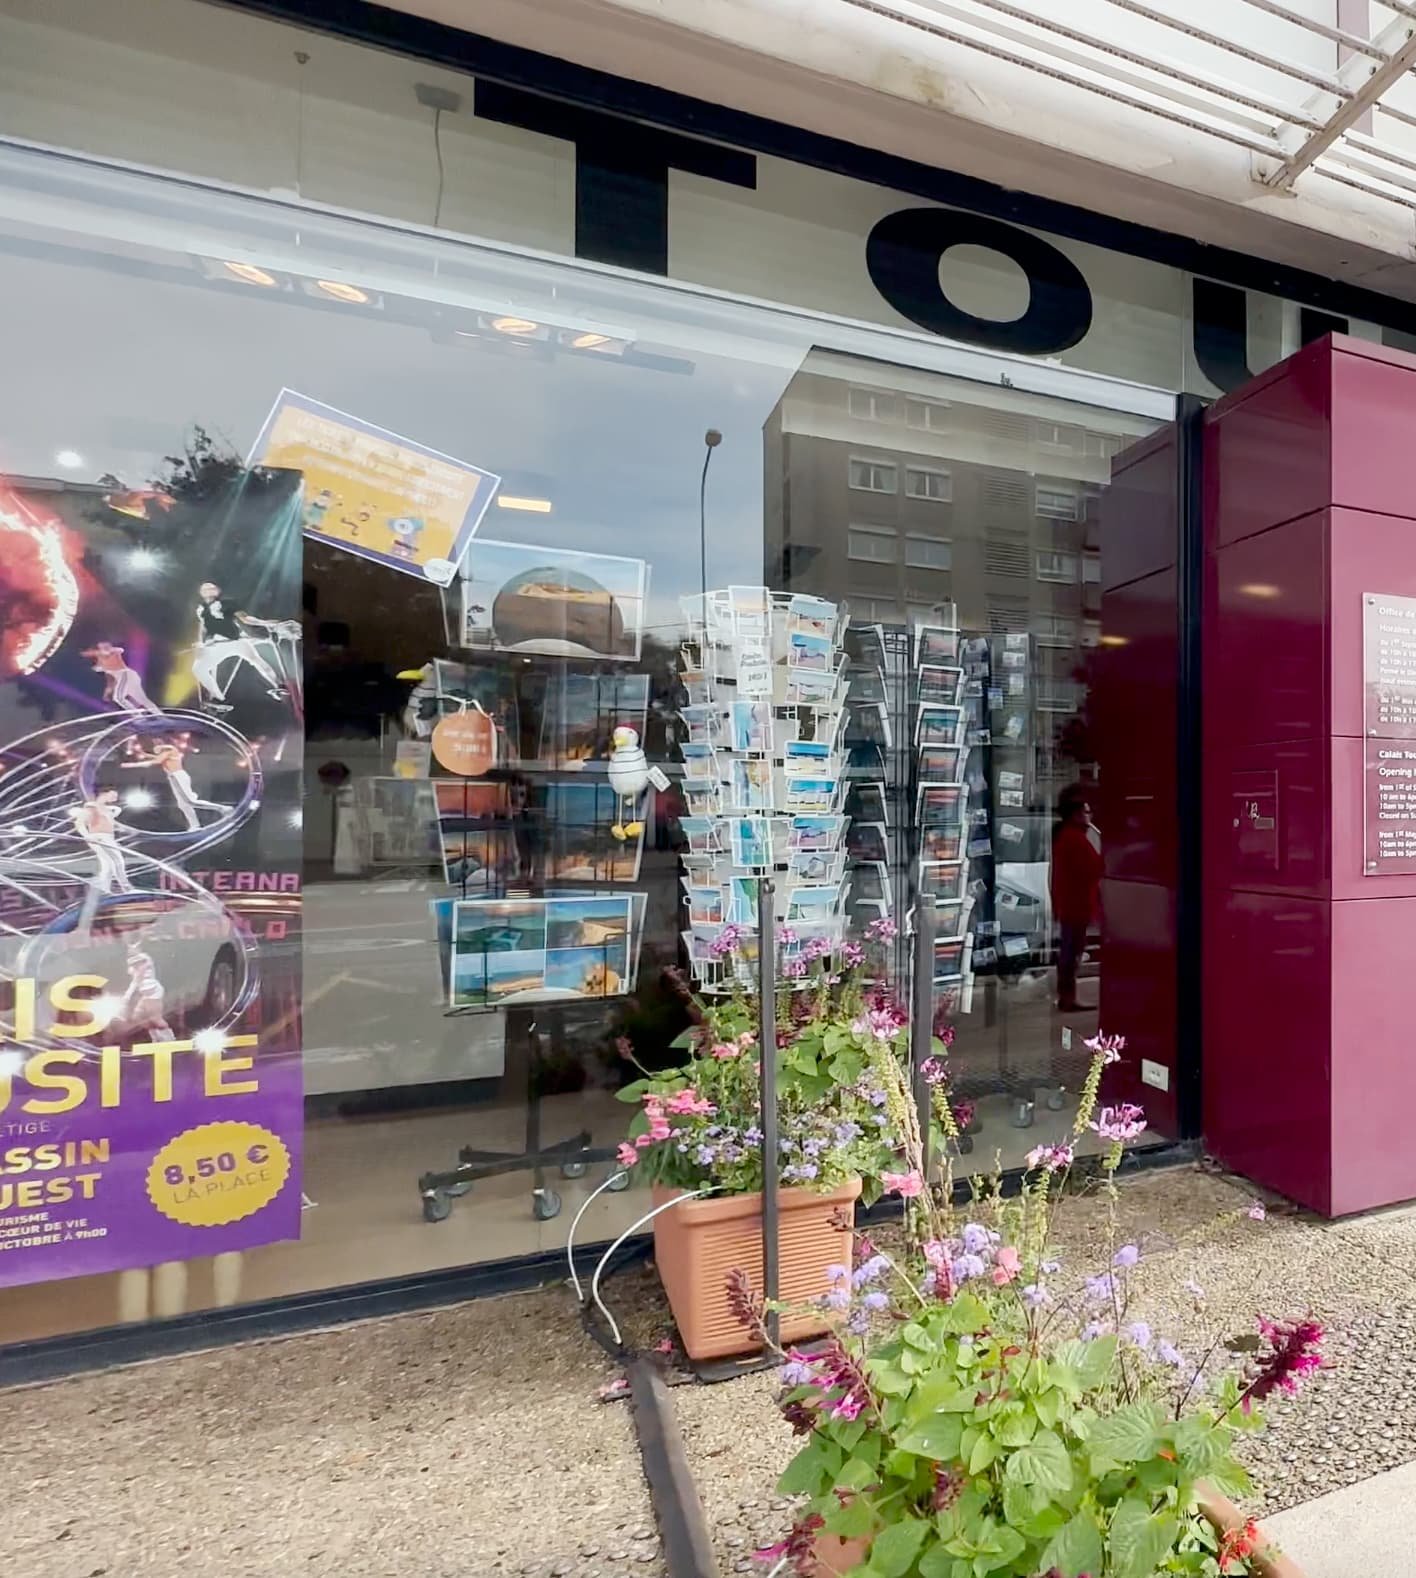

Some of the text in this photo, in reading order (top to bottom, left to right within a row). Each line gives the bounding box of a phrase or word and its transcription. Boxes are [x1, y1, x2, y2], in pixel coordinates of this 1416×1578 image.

[1379, 750, 1403, 760] Calais
[1379, 767, 1412, 779] Opening
[164, 1143, 270, 1186] 8,50 €
[173, 1168, 273, 1204] LA PLACE
[44, 1221, 63, 1233] DE
[66, 1217, 88, 1230] VIE
